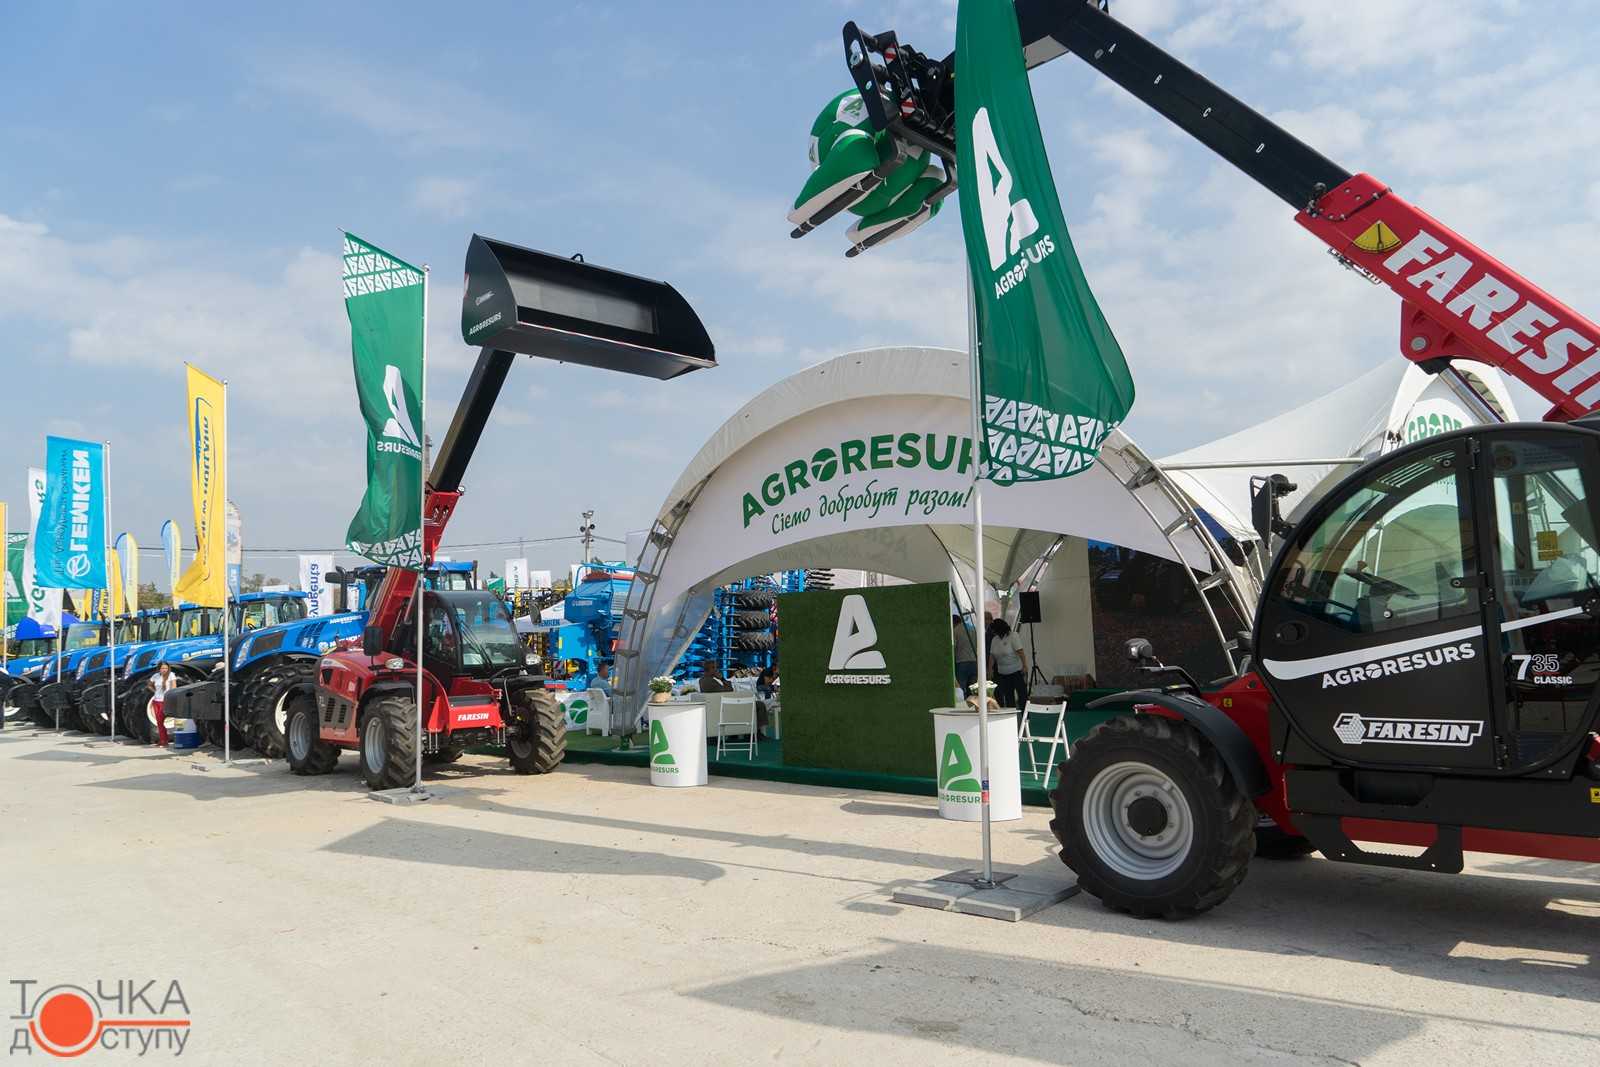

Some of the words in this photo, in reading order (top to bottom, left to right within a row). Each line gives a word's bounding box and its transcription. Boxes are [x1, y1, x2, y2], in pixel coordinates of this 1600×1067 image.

[743, 432, 1013, 528] AGRORESUR
[820, 479, 899, 522] добробут
[1321, 642, 1477, 689] AGRORESURS
[824, 674, 892, 685] AGRORESURS
[1533, 676, 1573, 684] CLASSIC
[457, 712, 489, 721] FARESIN
[1366, 721, 1471, 742] FARESIN
